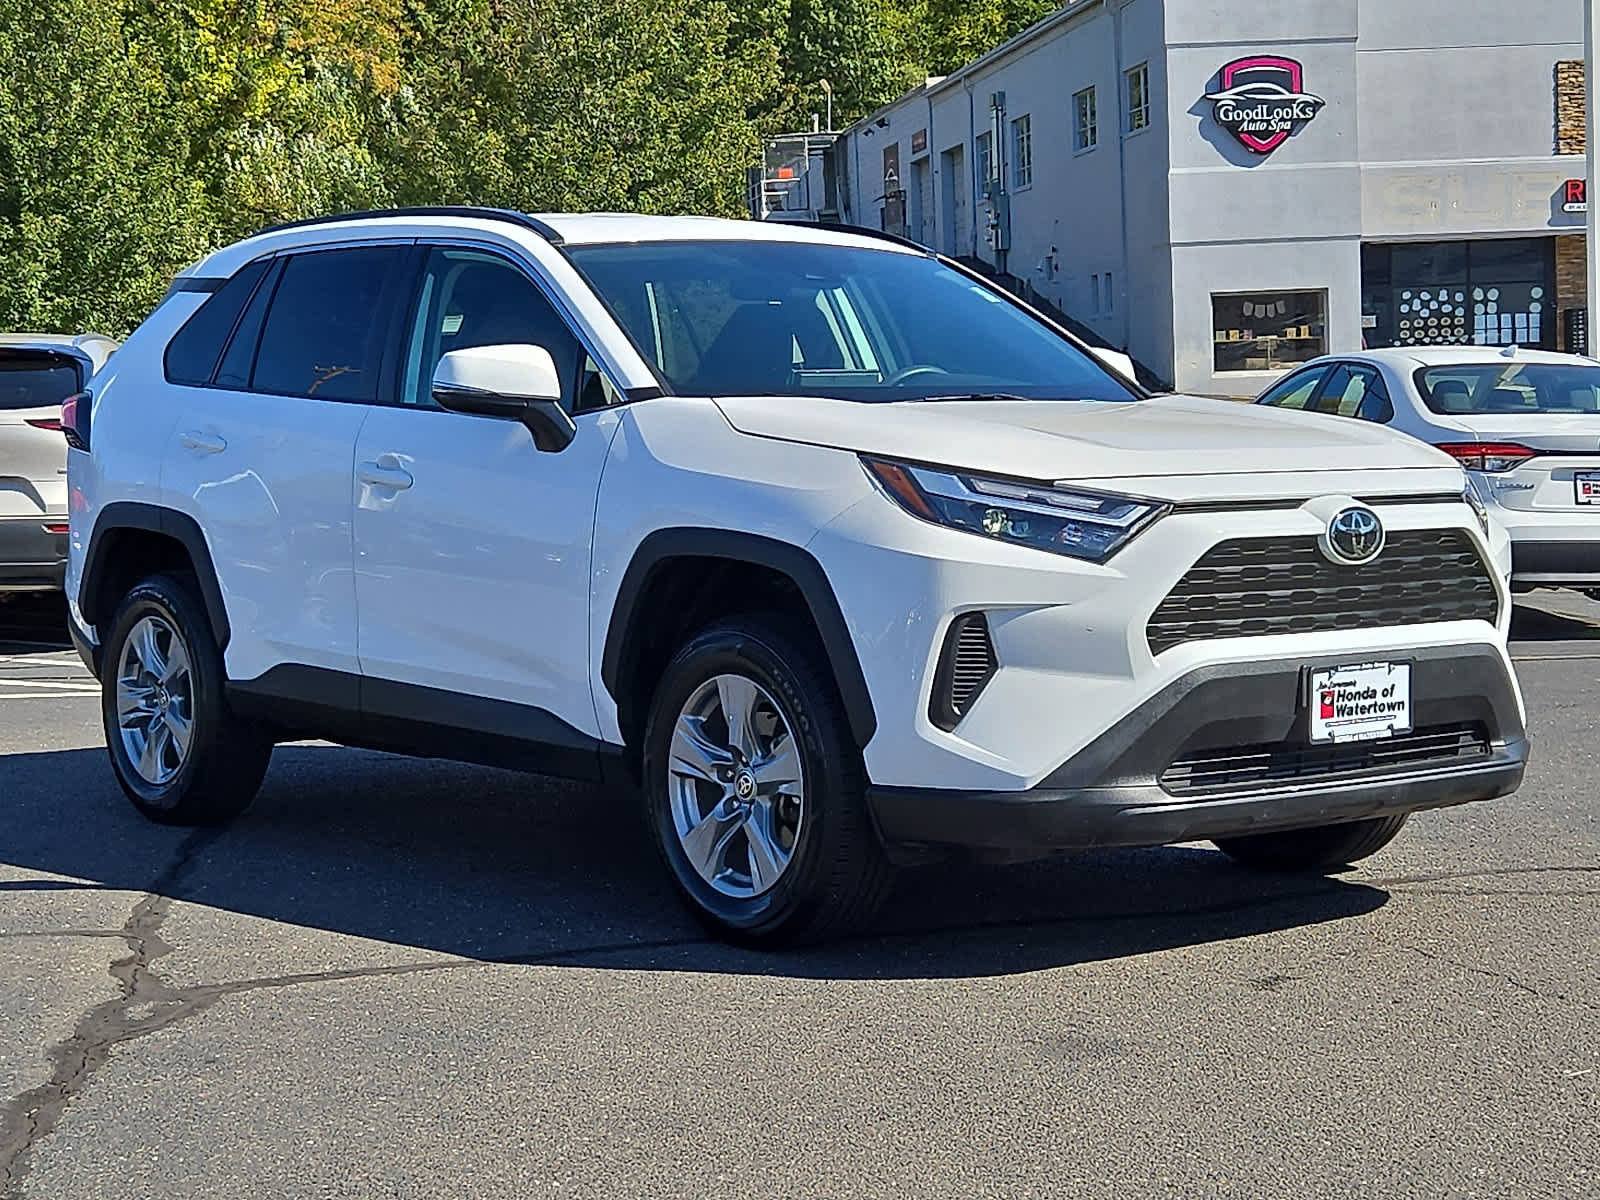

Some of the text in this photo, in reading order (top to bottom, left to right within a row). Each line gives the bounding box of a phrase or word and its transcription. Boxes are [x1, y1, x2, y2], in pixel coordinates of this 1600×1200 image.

[1239, 119, 1292, 132] Auto Spa
[1336, 686, 1377, 703] Honda
[1382, 683, 1396, 698] of
[1336, 701, 1405, 718] Watertown
